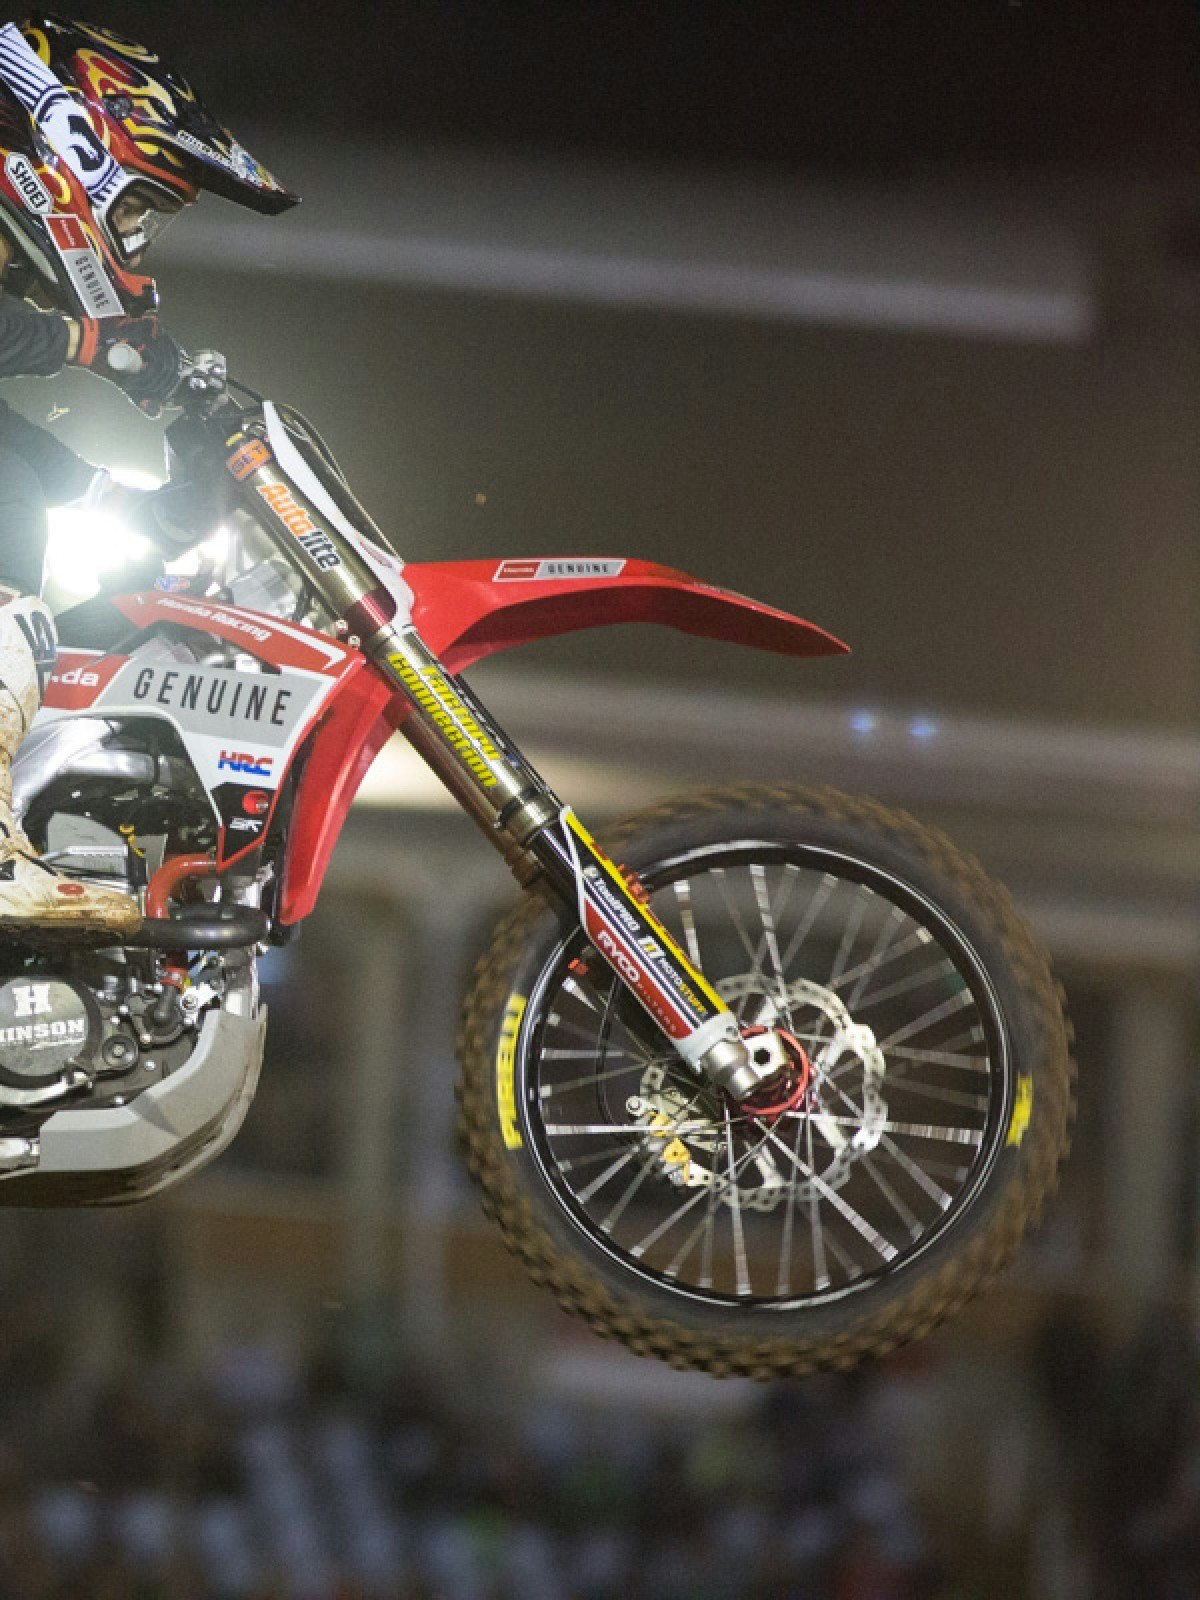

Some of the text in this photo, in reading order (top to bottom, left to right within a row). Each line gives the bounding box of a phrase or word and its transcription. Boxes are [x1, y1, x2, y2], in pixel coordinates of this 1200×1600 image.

[10, 159, 47, 210] SHOEI
[74, 255, 110, 309] GENUINE
[258, 483, 343, 571] Autolite
[547, 562, 609, 575] GENUINE
[211, 612, 273, 642] Racing
[133, 667, 292, 726] GENUINE
[218, 750, 274, 776] HRC
[597, 929, 641, 983] RYCO
